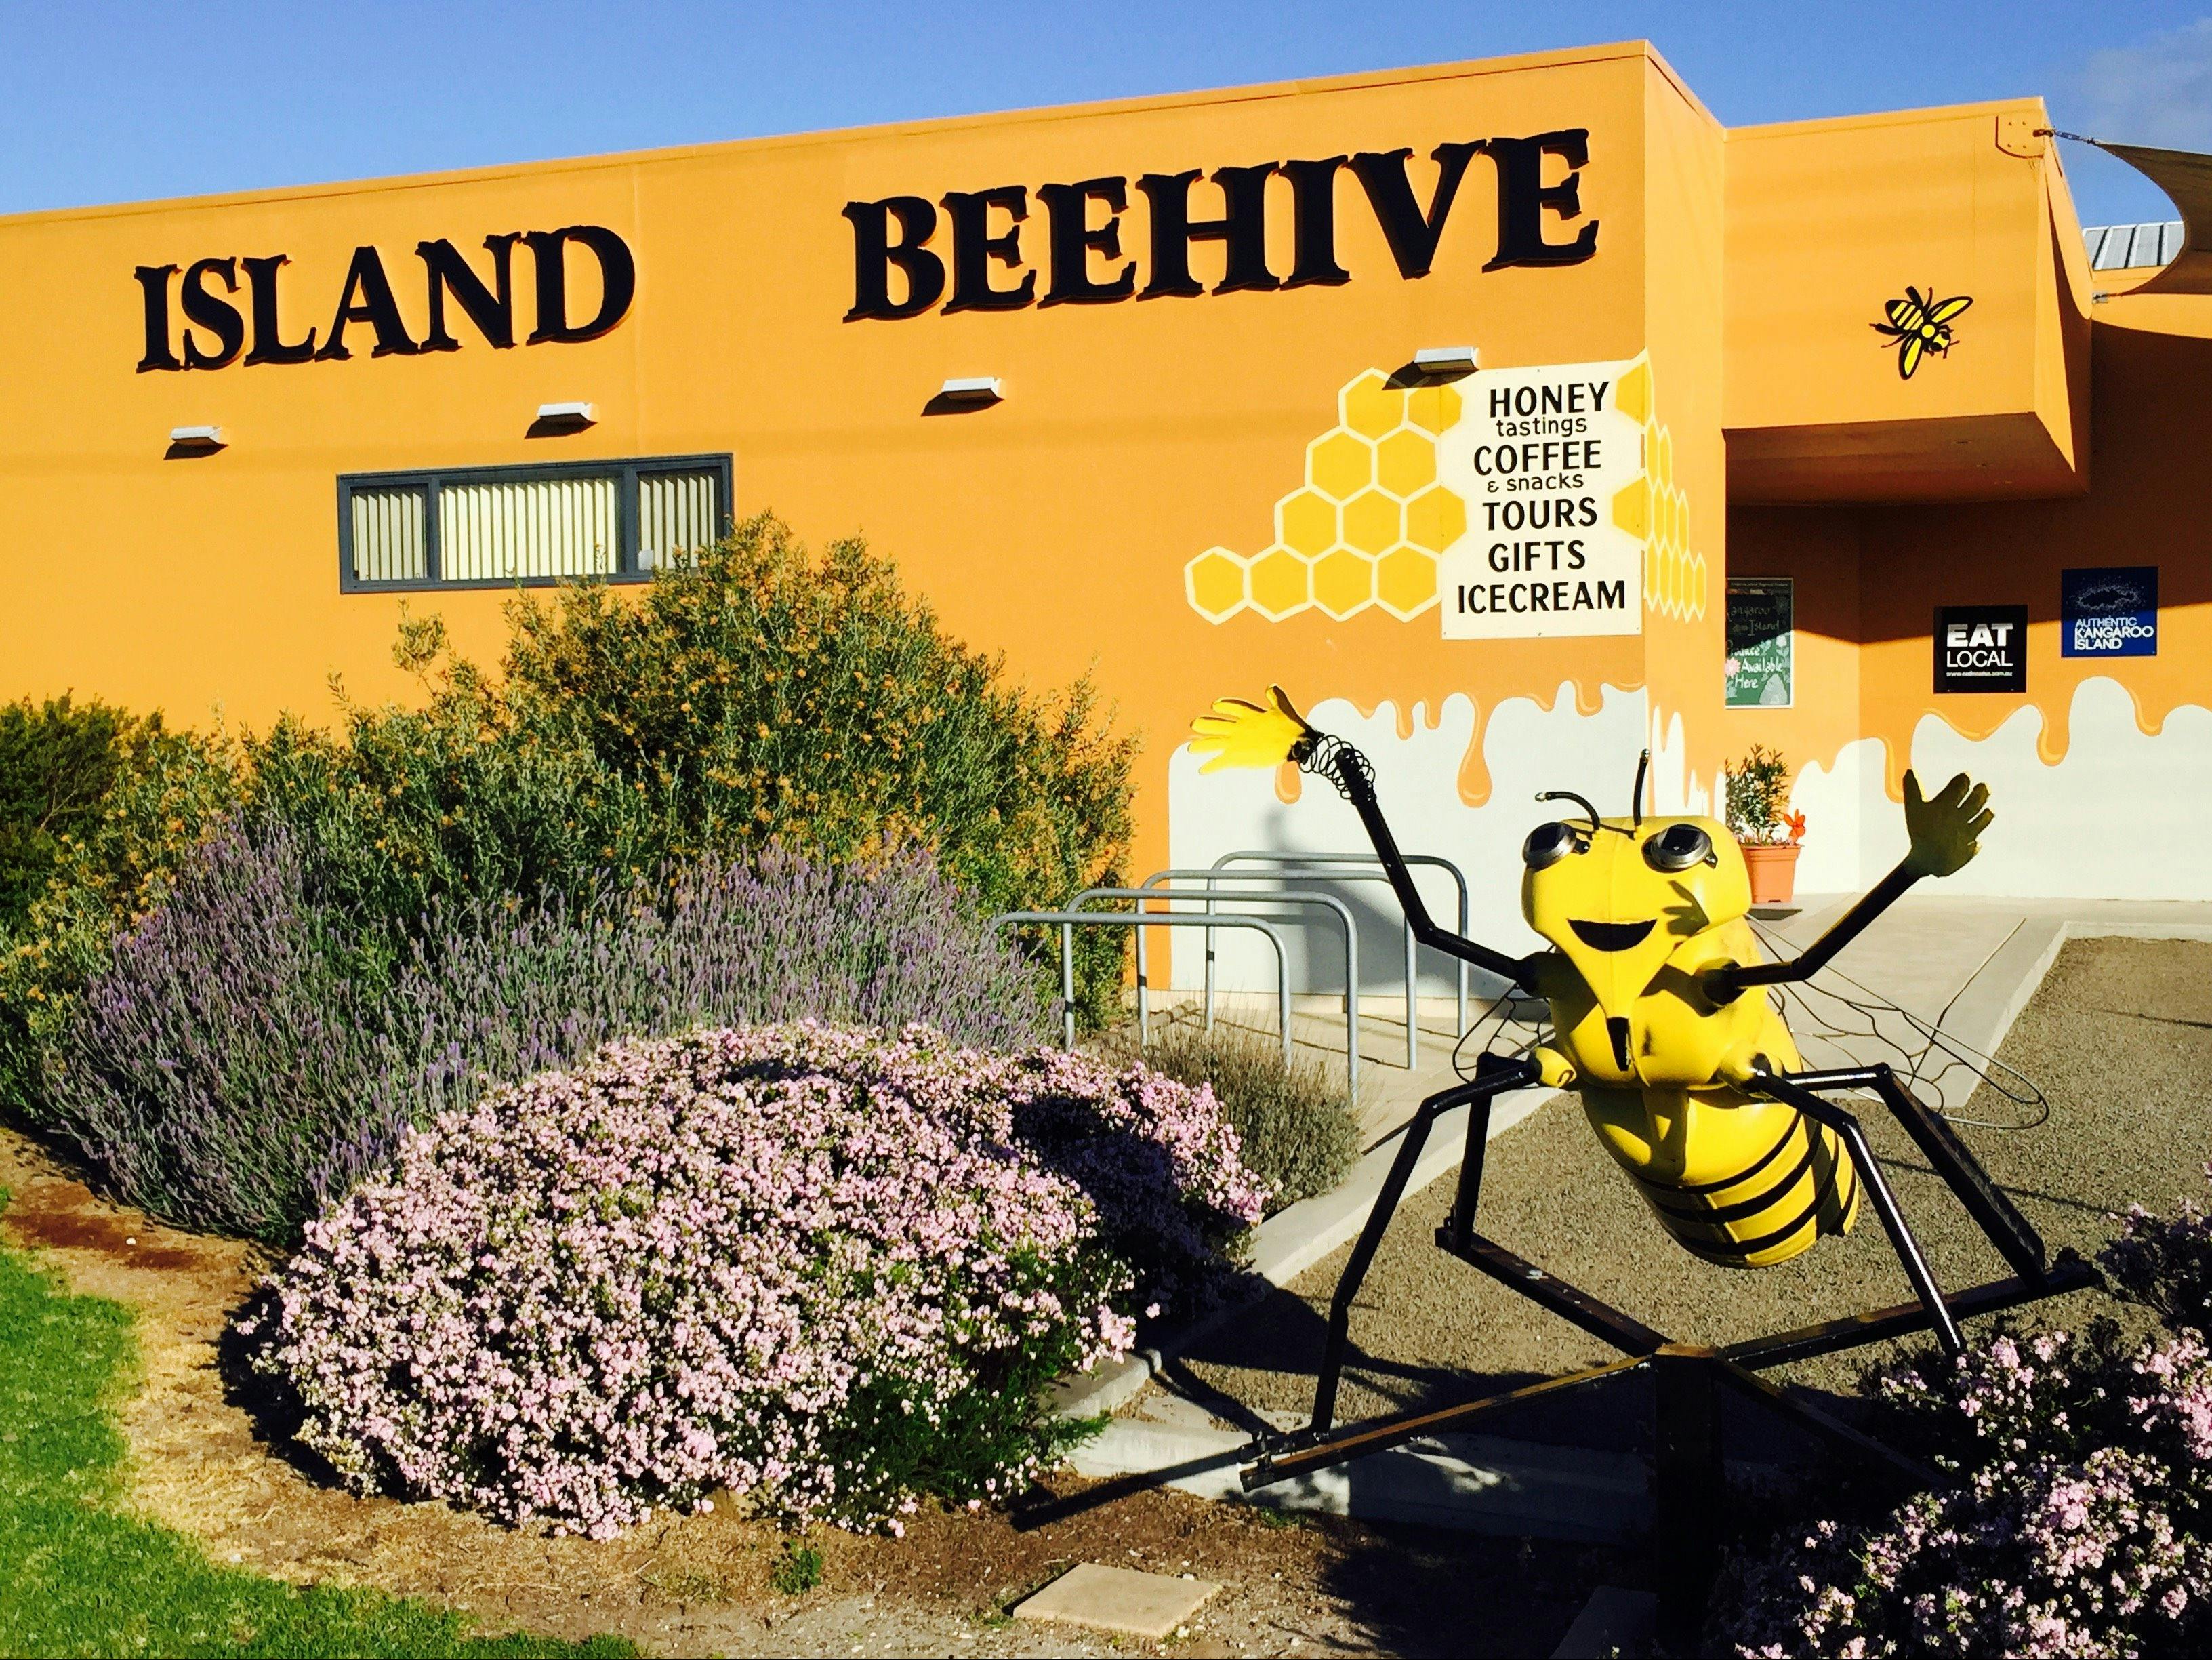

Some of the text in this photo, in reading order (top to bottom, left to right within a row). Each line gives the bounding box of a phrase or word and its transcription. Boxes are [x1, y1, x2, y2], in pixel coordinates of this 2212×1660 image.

[134, 129, 1599, 373] ISLAND BEEHIVE
[1490, 381, 1610, 418] HONEY
[1496, 416, 1588, 438] tastings
[1473, 439, 1602, 476] COFFEE
[1487, 472, 1584, 493] & snacks
[1482, 496, 1598, 531] TOURS
[1488, 540, 1586, 573] GIFTS
[1458, 580, 1625, 614] ICECREAM
[2075, 625, 2154, 639] KANGAROO
[2076, 616, 2137, 628] AUTHENTIC
[1946, 623, 2013, 647] EAT
[2075, 637, 2123, 651] ISLAND
[1742, 656, 1784, 673] Available
[1946, 649, 2013, 668] LOCAL
[1735, 675, 1759, 689] Here
